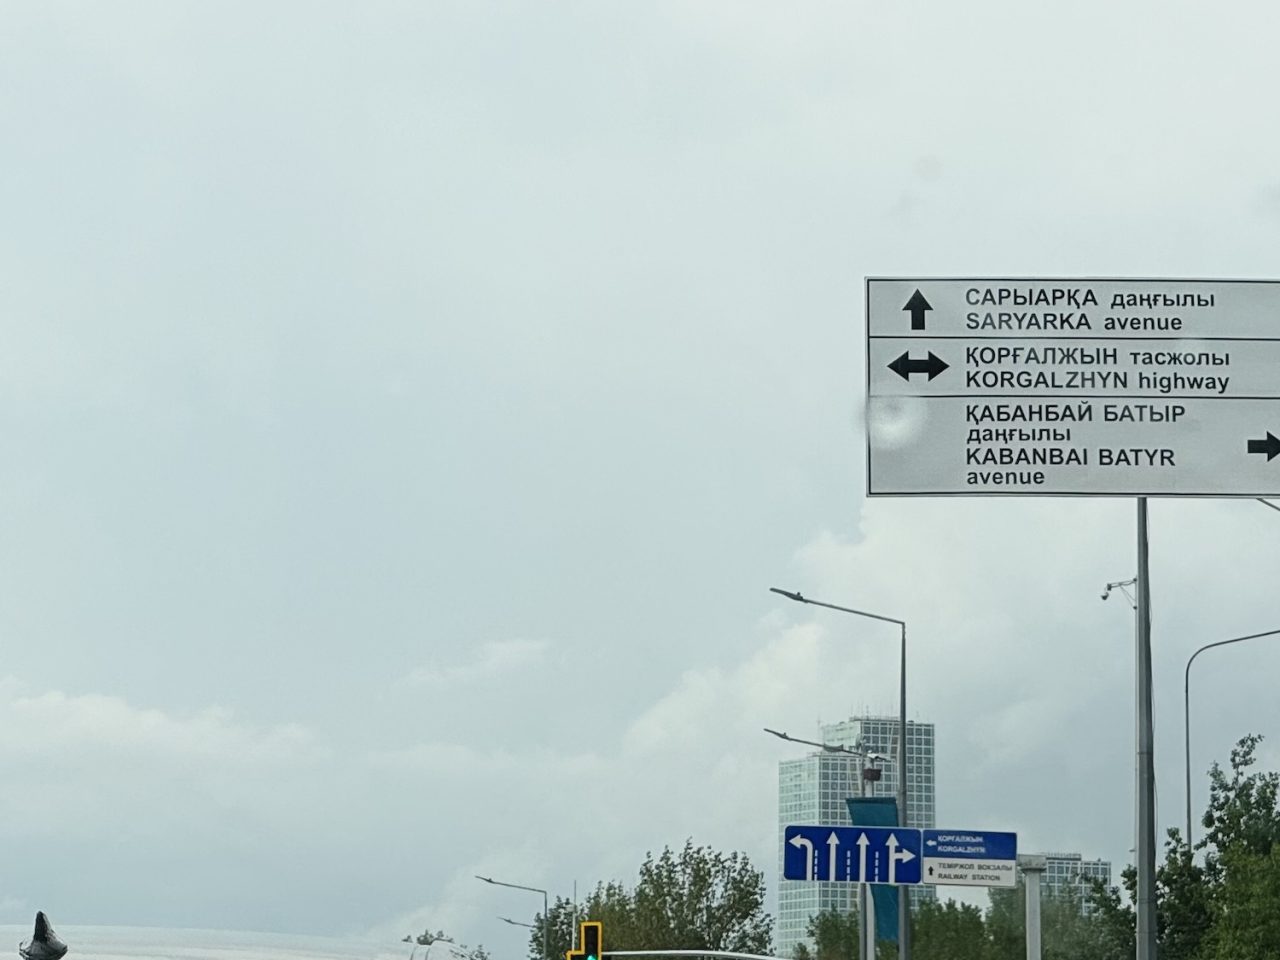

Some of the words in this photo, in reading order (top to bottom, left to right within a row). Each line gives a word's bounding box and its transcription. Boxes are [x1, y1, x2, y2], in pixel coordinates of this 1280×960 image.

[965, 287, 1099, 310] САРЫАРҚА
[1110, 293, 1215, 310] даңғылы
[965, 312, 1093, 331] SARYARKA
[1103, 316, 1183, 331] avenue
[965, 346, 1118, 368] ҚОРҒАЛЖЫН
[1129, 351, 1230, 366] тасжолы
[966, 370, 1128, 389] KORGALZHYN
[1138, 371, 1230, 395] highway
[965, 400, 1093, 426] ҚАБАНБАЙ
[1103, 404, 1186, 423] БАТЫР
[966, 427, 1071, 445] даңғылы
[966, 447, 1088, 466] KABANBAI
[1098, 448, 1176, 467] BATYR
[966, 471, 1046, 486] avenue
